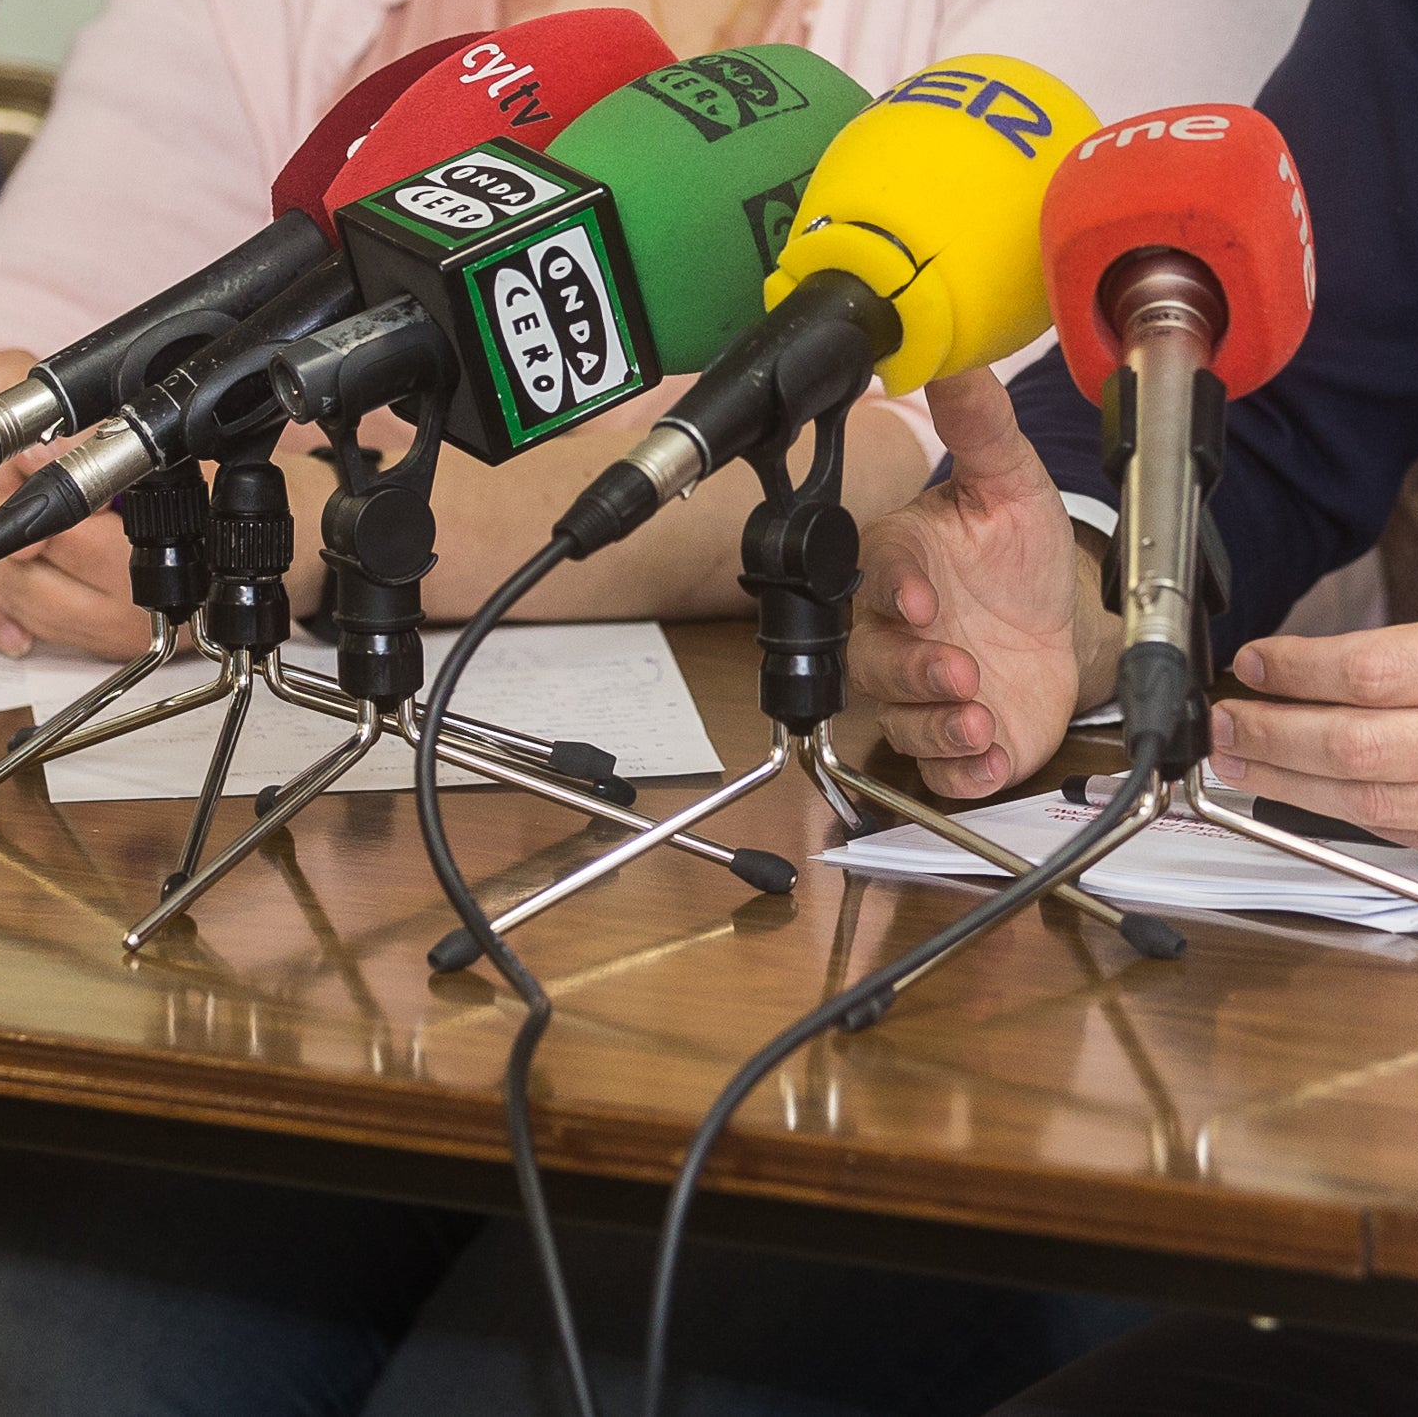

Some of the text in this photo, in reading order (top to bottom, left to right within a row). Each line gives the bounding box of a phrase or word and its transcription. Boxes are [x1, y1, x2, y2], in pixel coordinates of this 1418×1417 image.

[1078, 115, 1230, 160] rne
[410, 190, 483, 224] CERO
[451, 166, 527, 204] ONDA
[548, 256, 600, 375] ONDA
[506, 286, 555, 393] CERO
